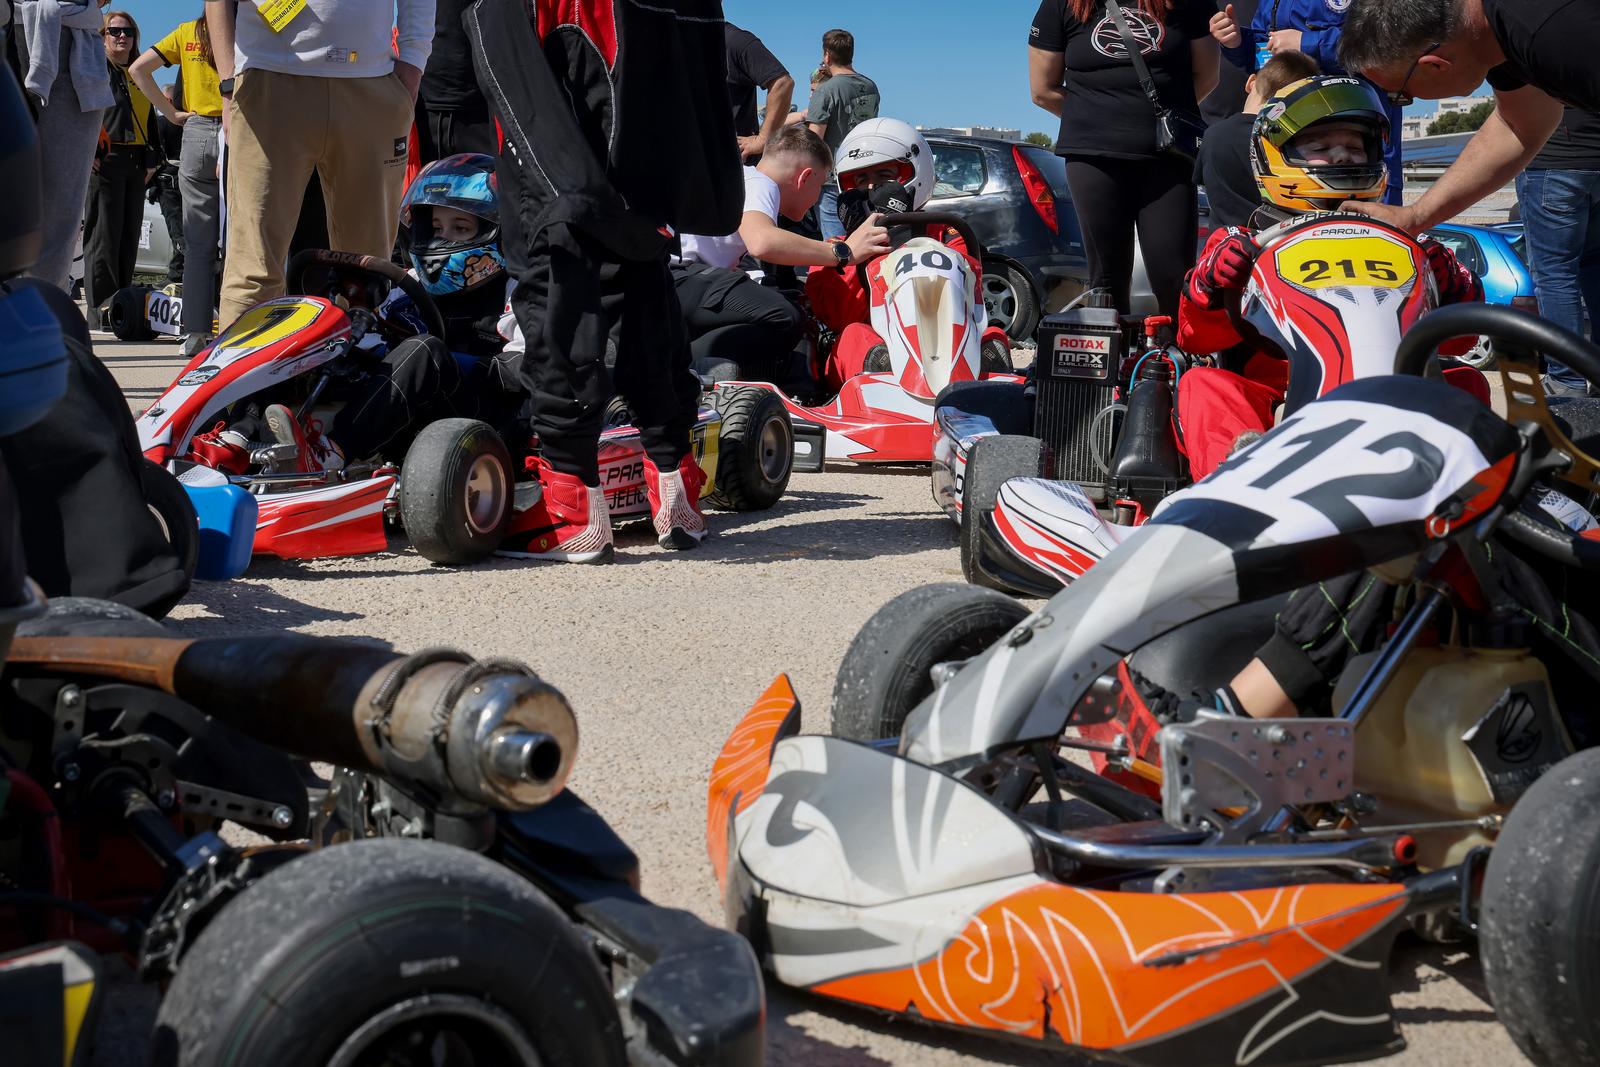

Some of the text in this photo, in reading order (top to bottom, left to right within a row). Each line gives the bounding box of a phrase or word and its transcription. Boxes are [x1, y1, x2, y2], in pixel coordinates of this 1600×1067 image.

[1320, 228, 1370, 236] PAROLIN
[1299, 259, 1398, 284] 215
[149, 297, 181, 327] 402
[1060, 338, 1104, 350] ROTAX
[1058, 352, 1103, 364] MAX
[1057, 361, 1103, 369] CHALLENGE
